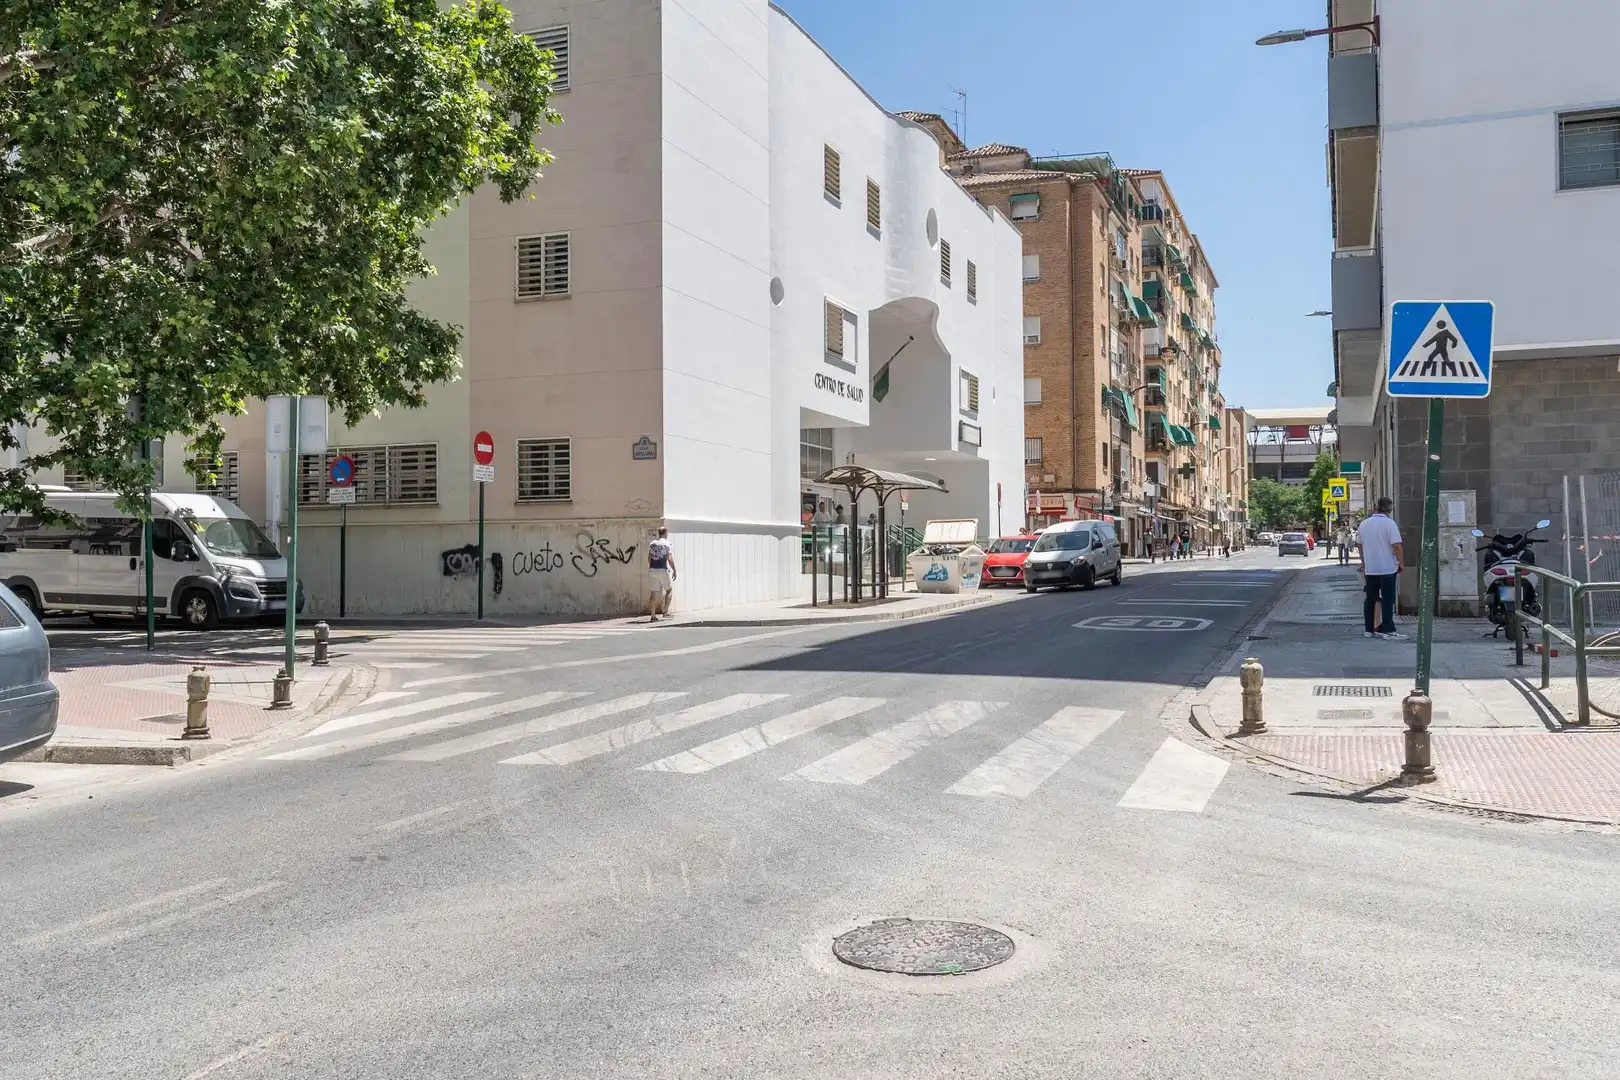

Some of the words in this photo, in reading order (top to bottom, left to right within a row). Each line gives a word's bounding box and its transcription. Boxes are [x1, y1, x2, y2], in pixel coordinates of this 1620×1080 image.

[814, 372, 837, 394] CENTRO
[838, 380, 845, 397] DE
[847, 384, 864, 403] SALUD
[1099, 618, 1187, 628] 30
